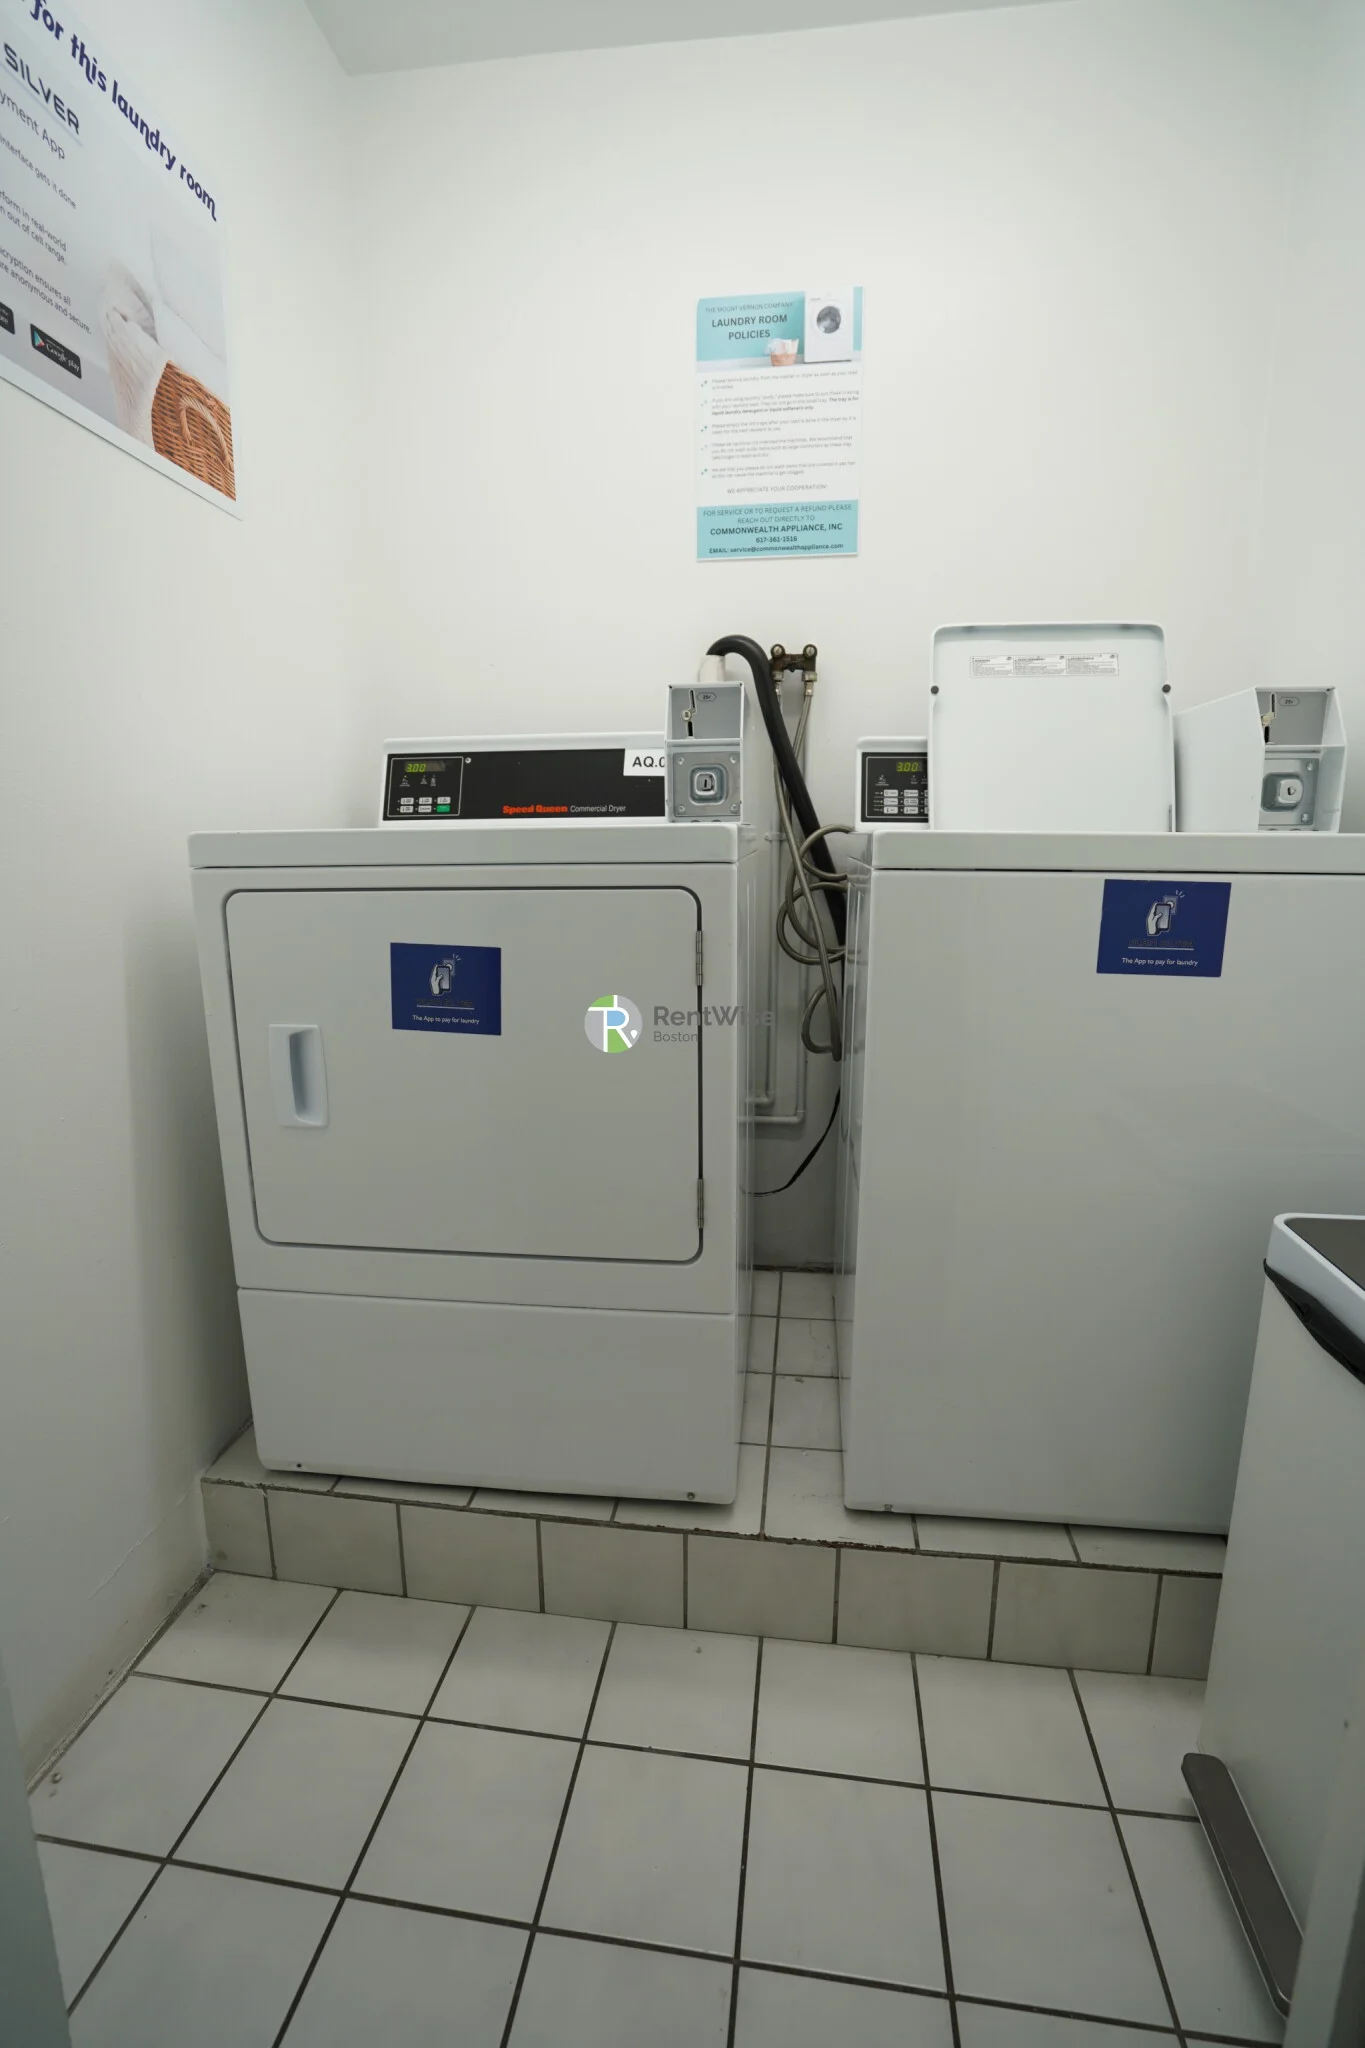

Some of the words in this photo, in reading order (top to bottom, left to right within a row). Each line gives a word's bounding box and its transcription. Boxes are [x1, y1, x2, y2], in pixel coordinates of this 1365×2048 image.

[4, 42, 79, 135] SILVER
[30, 0, 64, 40] for
[71, 33, 106, 92] this
[112, 80, 176, 170] laundry
[180, 164, 217, 221] room
[43, 128, 65, 160] App
[35, 167, 50, 186] gets
[59, 189, 76, 209] done
[7, 211, 20, 228] out
[22, 224, 29, 235] of
[31, 231, 43, 246] cell
[22, 208, 29, 221] in
[31, 217, 66, 252] real-world
[10, 268, 53, 306] anonymous
[54, 302, 68, 317] and
[35, 274, 62, 299] ensures
[711, 316, 756, 328] LAUNDRY
[758, 314, 788, 324] ROOM
[728, 329, 771, 340] POLICIES
[717, 508, 743, 516] SERVICE
[764, 506, 793, 514] REQUEST
[710, 525, 779, 535] COMMONWEALTH
[781, 523, 827, 532] APPLIANCE,
[828, 522, 843, 530] INC
[730, 543, 844, 553] service@commonwealthappliance.com
[502, 805, 535, 815] Speed
[535, 804, 568, 813] Queen
[570, 804, 607, 813] Commercial
[608, 804, 627, 814] Dryer
[1176, 959, 1199, 967] laundry
[460, 1017, 480, 1025] laundry
